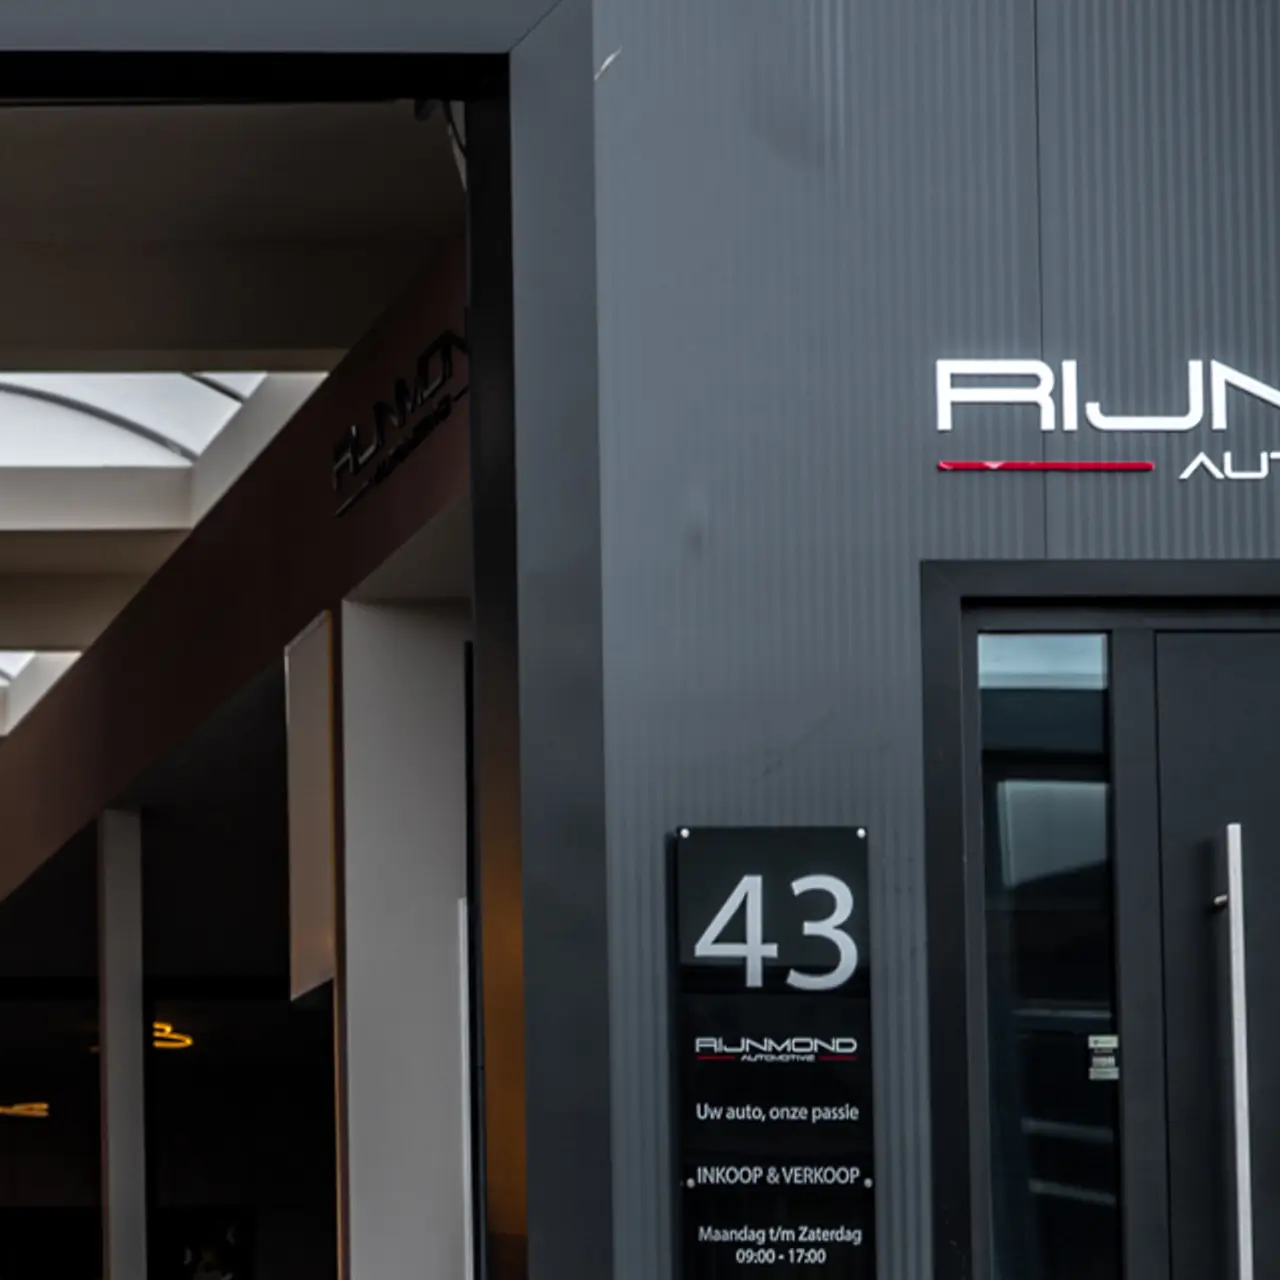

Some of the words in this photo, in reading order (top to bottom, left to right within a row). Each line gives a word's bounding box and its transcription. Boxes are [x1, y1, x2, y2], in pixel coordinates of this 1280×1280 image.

[1179, 451, 1280, 479] AU
[695, 874, 858, 990] 43
[695, 1037, 857, 1053] RIJNMOND
[741, 1053, 815, 1062] AUTOMOTIVE
[696, 1103, 723, 1119] Uw
[726, 1104, 765, 1121] auto,
[769, 1107, 808, 1119] onze
[812, 1103, 859, 1123] passie
[697, 1167, 763, 1184] INKOOP
[766, 1167, 780, 1184] &
[782, 1167, 860, 1184] VERKOOP
[698, 1226, 765, 1245] Maandag
[769, 1226, 795, 1242] t/m
[798, 1226, 862, 1246] Zaterdag
[735, 1249, 775, 1264] 09:00
[788, 1249, 827, 1264] 17:00
